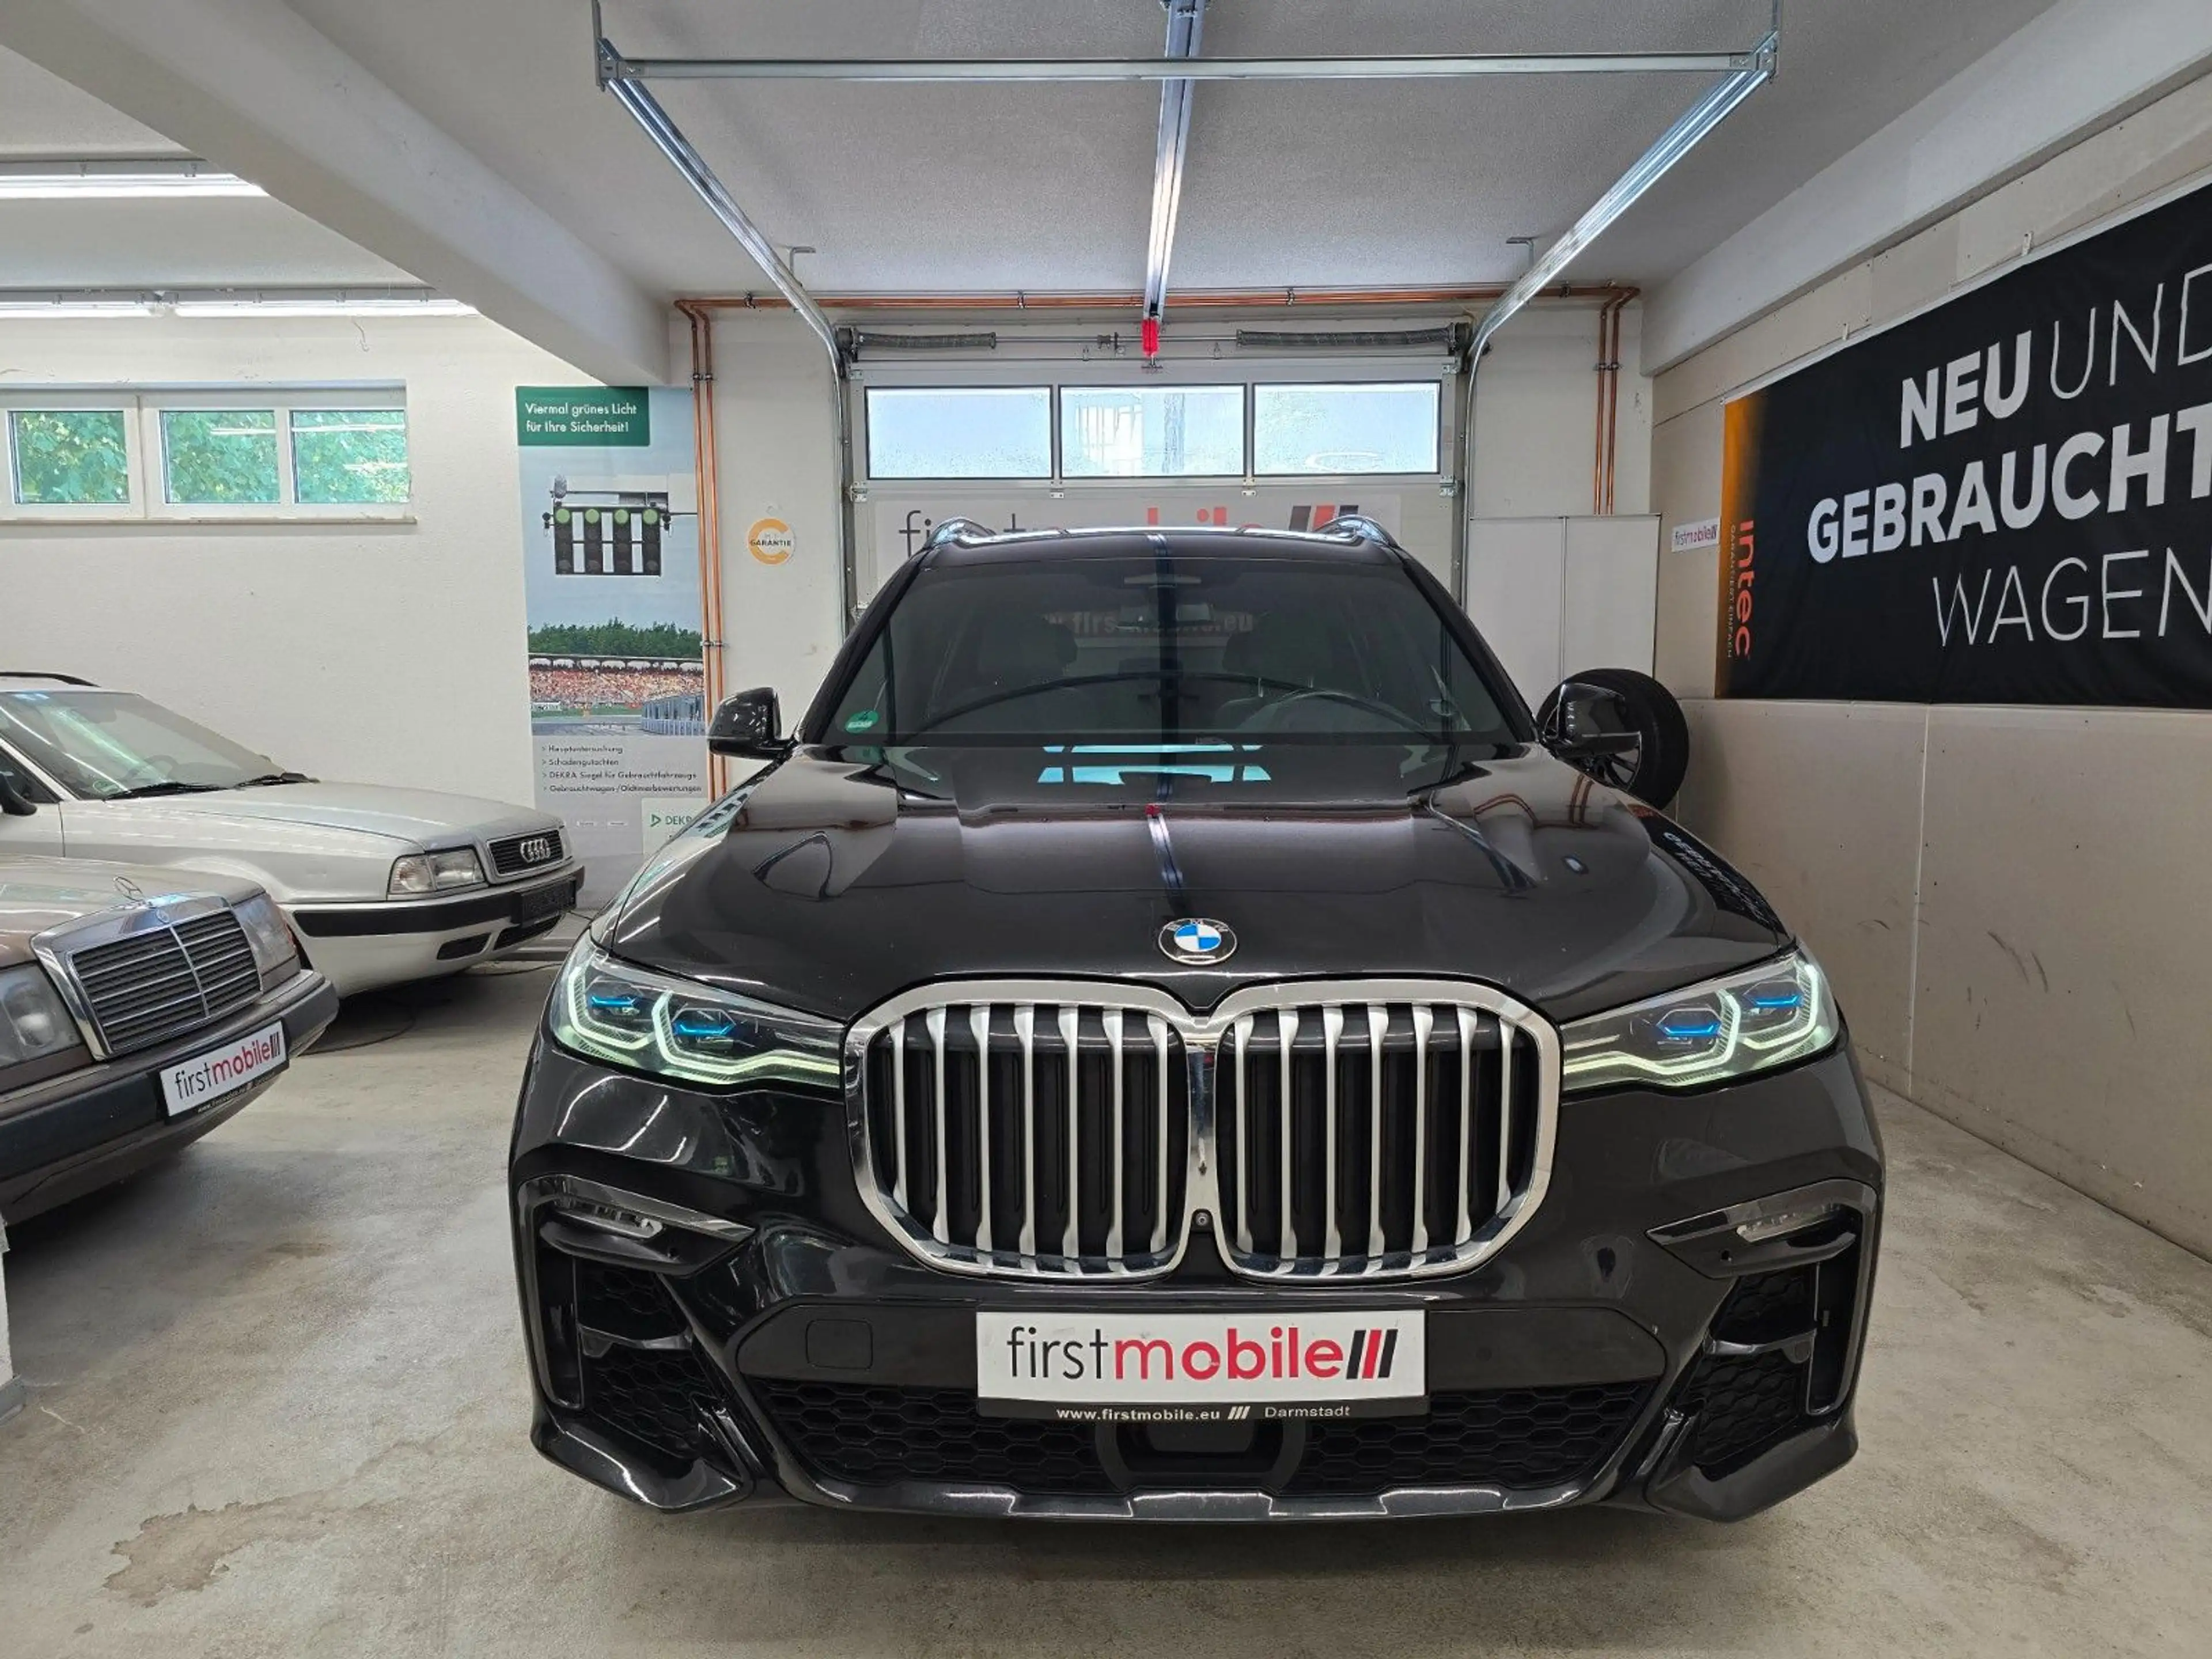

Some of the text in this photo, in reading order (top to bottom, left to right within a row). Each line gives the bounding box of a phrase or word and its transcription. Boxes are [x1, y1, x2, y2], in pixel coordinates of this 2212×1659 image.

[1900, 263, 2212, 449] NEU UND
[525, 402, 637, 418] Viermal grünes Licht
[526, 420, 629, 433] für Ihre Sicherheit!
[1808, 402, 2212, 563] GEBRAUCHT
[1734, 520, 1755, 657] intec
[1933, 547, 2212, 646] WAGEN
[665, 815, 692, 825] DEKR
[175, 1039, 271, 1100] firstmobile
[1007, 1325, 1344, 1381] firstmobile
[1056, 1406, 1351, 1421] www.firstmobile.eu Darmstadt
